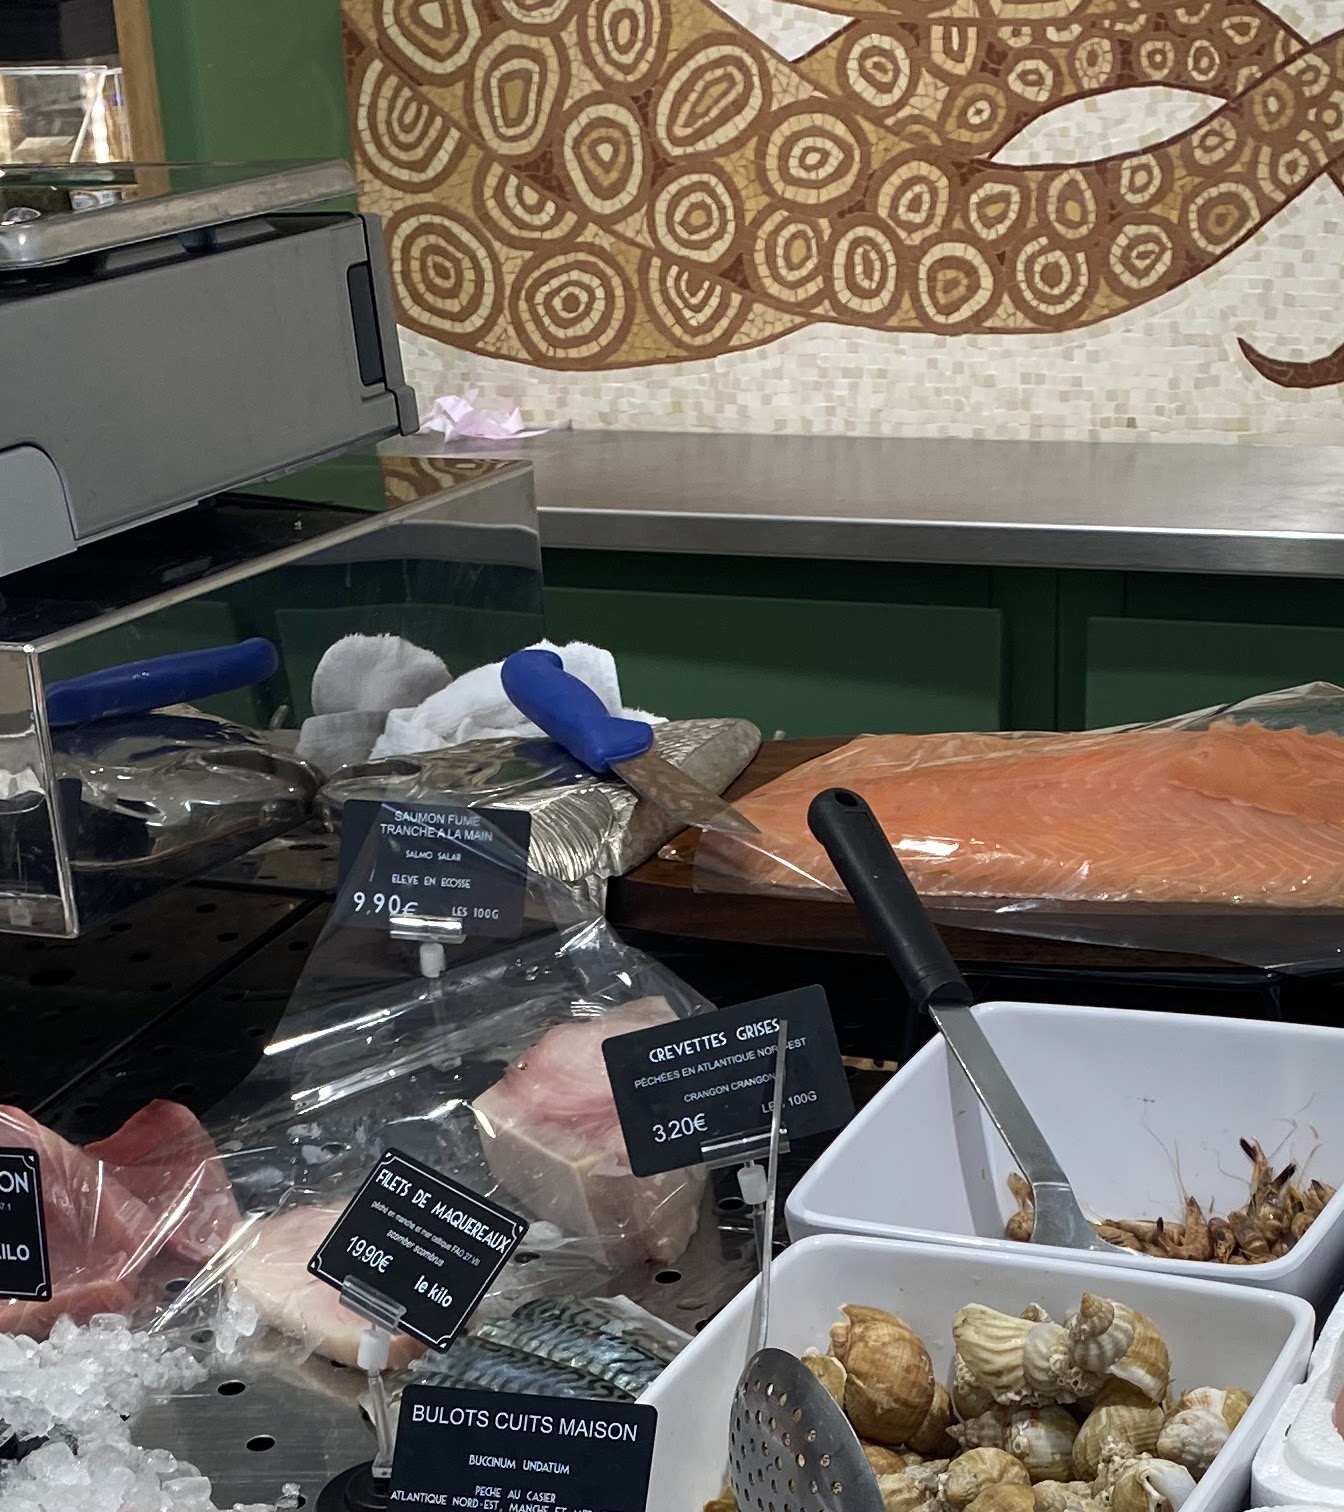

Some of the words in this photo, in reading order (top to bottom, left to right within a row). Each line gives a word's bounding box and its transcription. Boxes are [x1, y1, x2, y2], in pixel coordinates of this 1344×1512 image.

[394, 811, 445, 824] SAUMON
[424, 876, 436, 885] EN
[441, 878, 471, 889] ECOSSE
[452, 906, 467, 917] LES
[474, 908, 499, 919] 100G
[648, 1032, 727, 1063] CREVETTES
[736, 1018, 780, 1041] GRISES
[375, 1168, 413, 1197] FILETS
[411, 1189, 432, 1209] DE
[430, 1202, 512, 1253] MAQUEREAUX
[413, 1275, 427, 1294] le
[428, 1282, 453, 1308] kilo
[412, 1404, 489, 1428] BULOTS
[495, 1412, 553, 1434] CUITS
[558, 1418, 638, 1442] MAISON
[469, 1455, 516, 1470] BUCCINUM
[523, 1460, 570, 1475] UNDATUM
